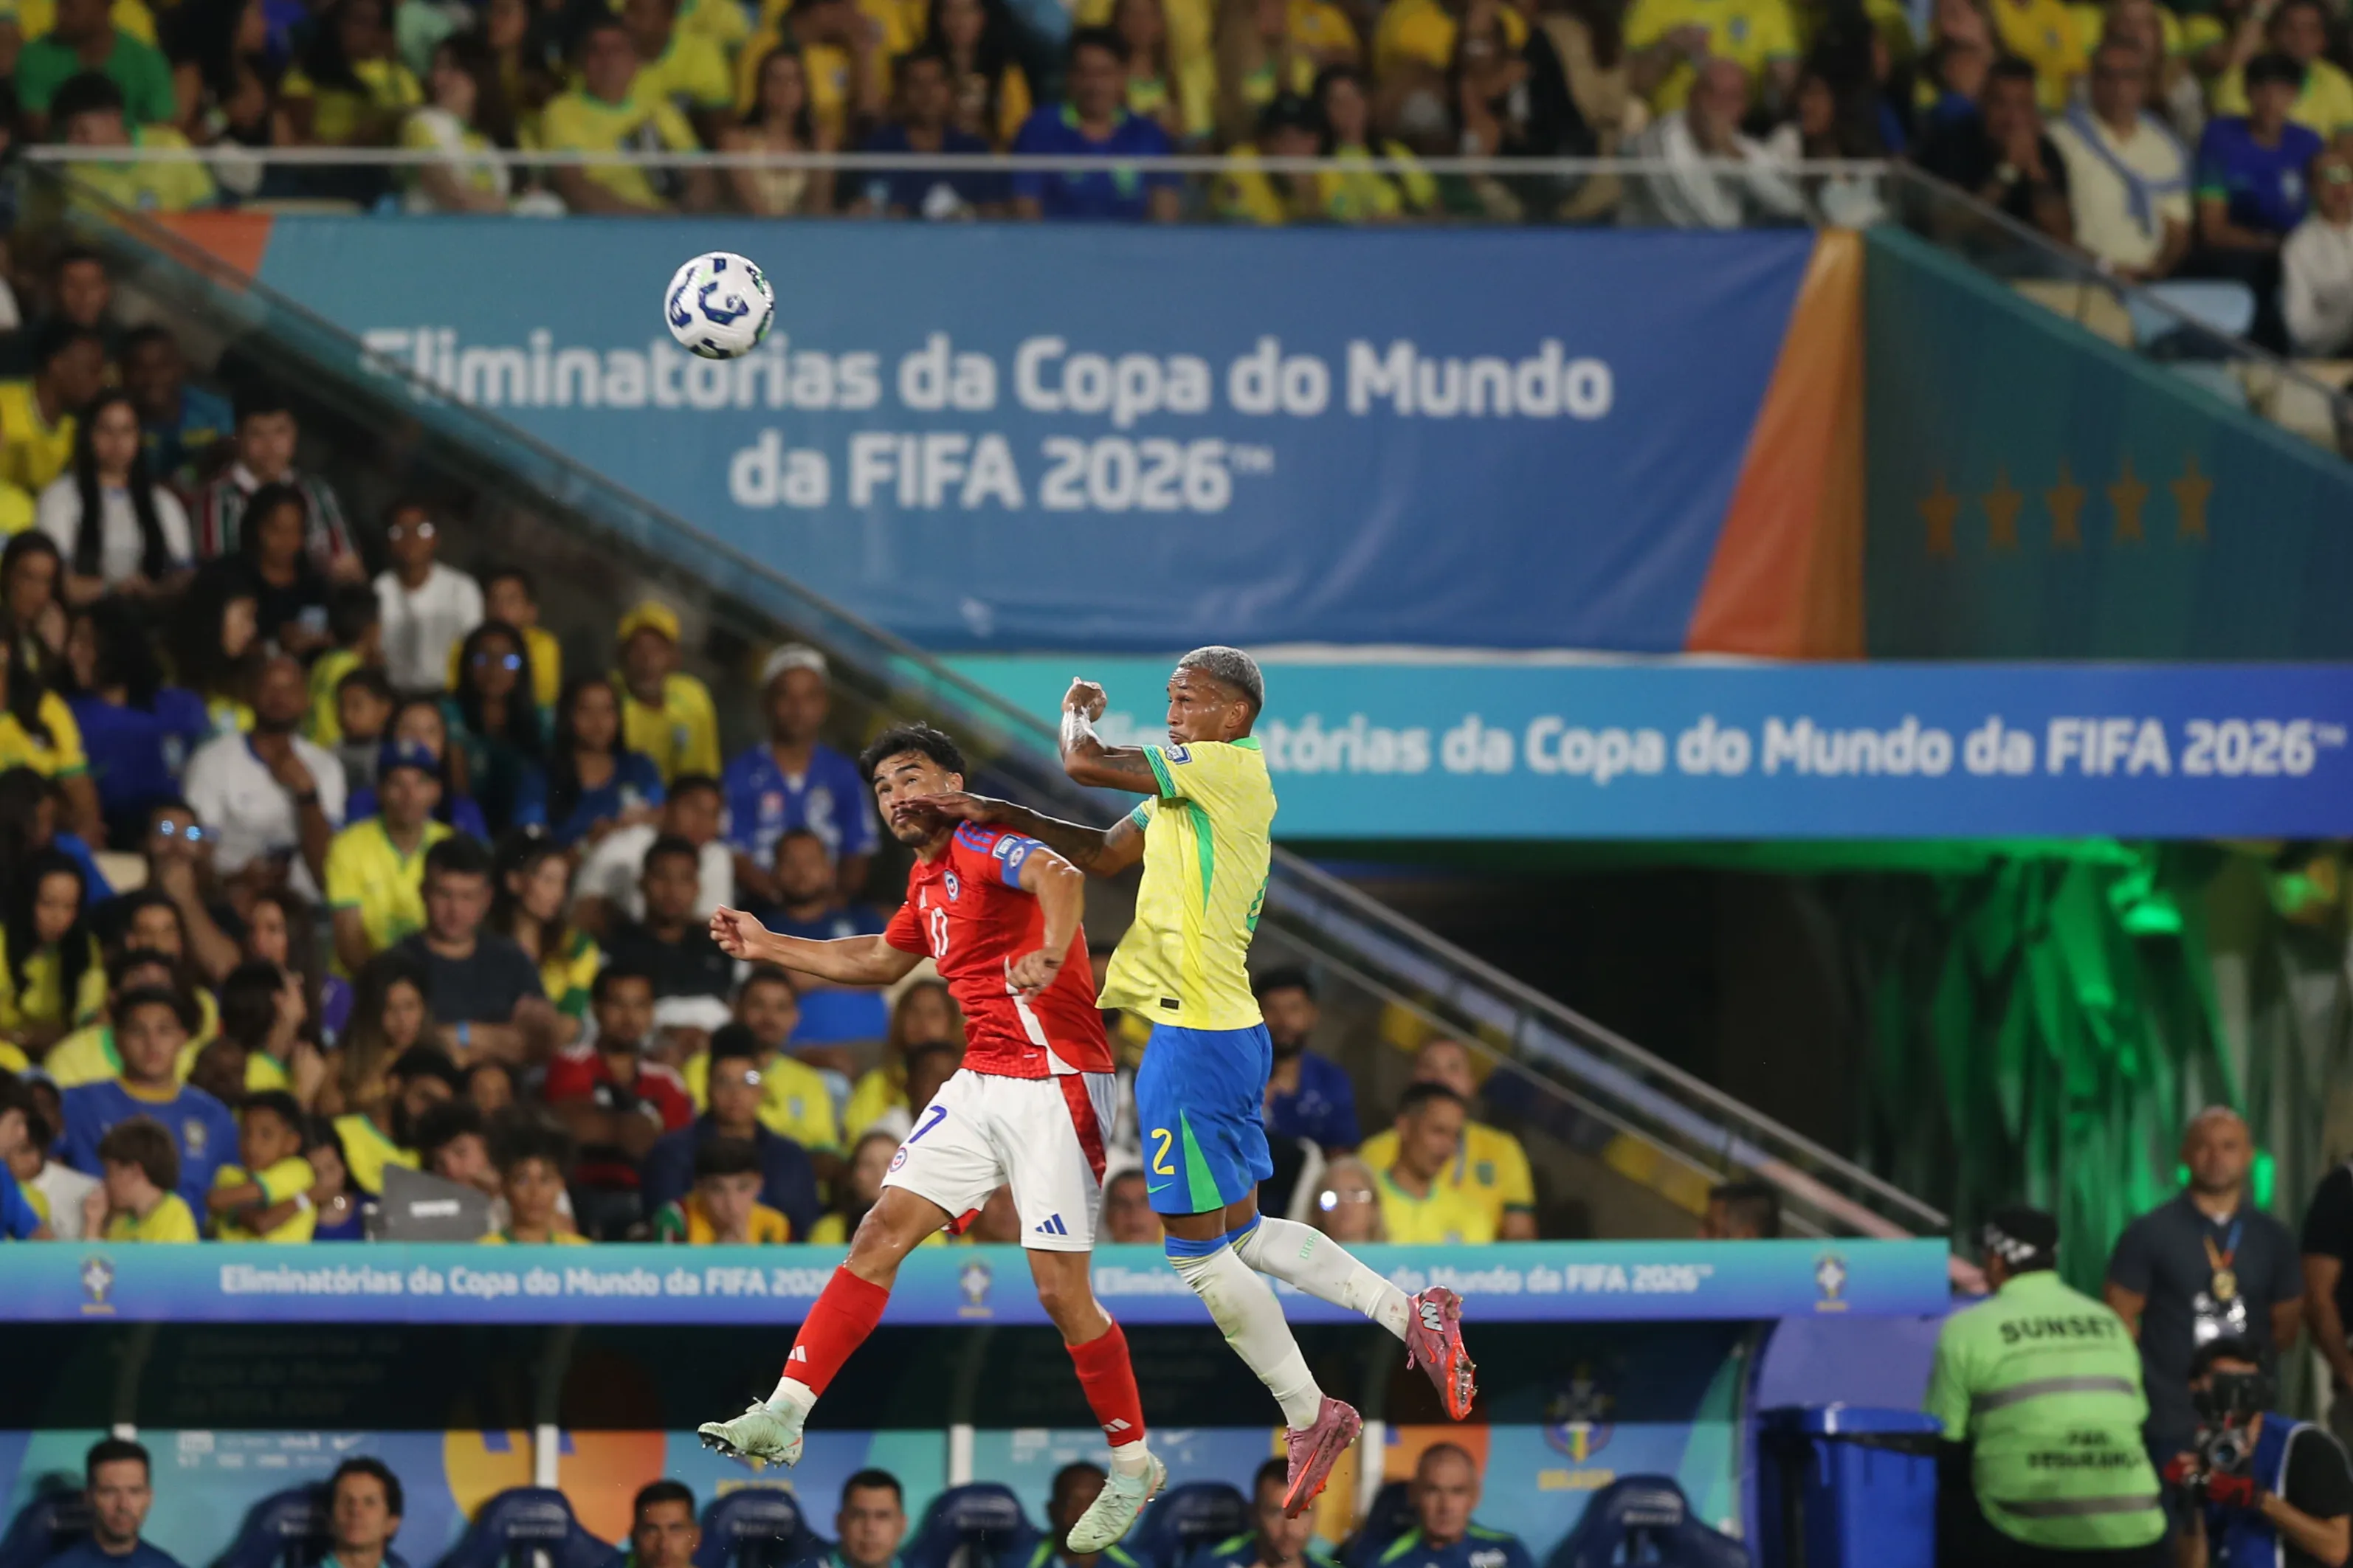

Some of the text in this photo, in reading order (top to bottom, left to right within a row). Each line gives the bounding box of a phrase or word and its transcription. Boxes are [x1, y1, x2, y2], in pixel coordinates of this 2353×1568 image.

[897, 331, 998, 412] da
[1014, 336, 1209, 426] Copa
[1228, 336, 1331, 415] do
[1346, 339, 1613, 419] Mundo
[728, 428, 831, 507] da
[847, 432, 1024, 509] FIFA
[1441, 714, 1515, 774] da
[1526, 715, 1667, 787] Copa
[1676, 715, 1752, 775] do
[1762, 715, 1954, 776] Mundo
[1963, 715, 2036, 776] da
[2047, 716, 2171, 776] FIFA
[931, 906, 949, 959] 17
[1151, 1127, 1175, 1175] 2
[219, 1264, 403, 1294] Eliminatórias
[408, 1265, 444, 1294] da
[449, 1265, 519, 1299] Copa
[523, 1266, 561, 1295] do
[563, 1266, 661, 1296] Mundo
[665, 1267, 701, 1296] da
[705, 1266, 768, 1296] FIFA
[1429, 1265, 1522, 1294] Mundo
[1526, 1265, 1563, 1294] da
[1565, 1264, 1628, 1294] FIFA
